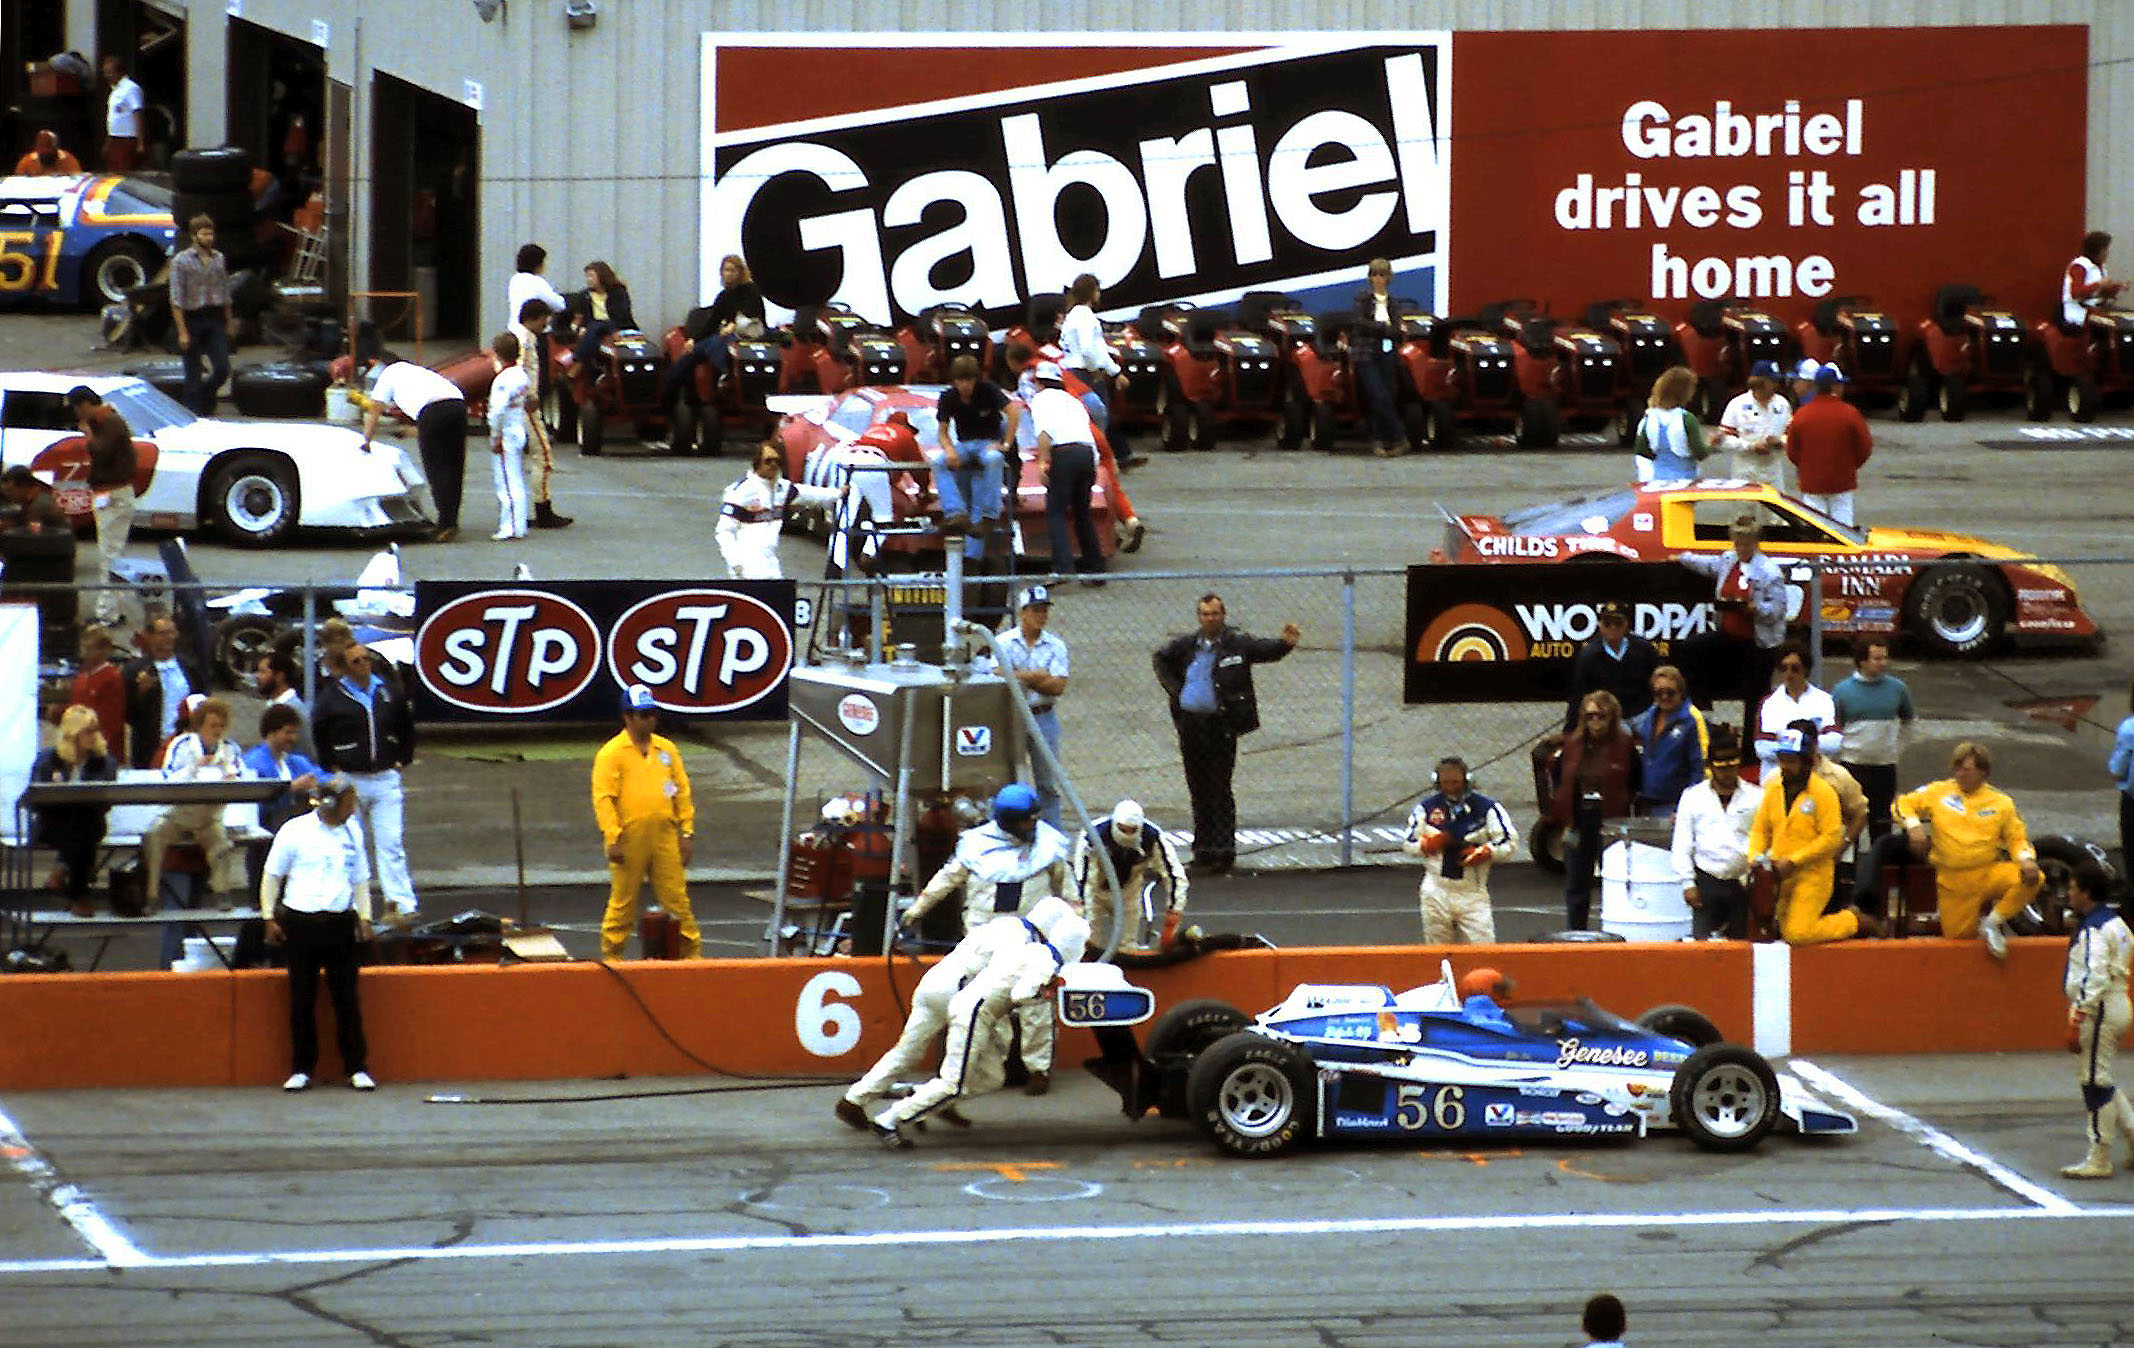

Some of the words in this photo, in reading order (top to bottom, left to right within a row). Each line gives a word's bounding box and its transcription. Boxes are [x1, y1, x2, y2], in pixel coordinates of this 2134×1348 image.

[1621, 100, 1863, 159] Gabriel
[714, 52, 1440, 328] Gabriel
[1554, 173, 1764, 229] drives
[1788, 170, 1836, 226] it
[1857, 168, 1936, 226] all
[0, 231, 63, 290] 51
[1651, 242, 1836, 299] home
[1479, 536, 1559, 557] CHILDS
[1841, 575, 1881, 596] INN
[438, 604, 578, 695] STP
[630, 604, 770, 695] STP
[1530, 643, 1575, 659] AUTO
[795, 970, 864, 1057] 6
[1068, 992, 1105, 1020] 56
[1555, 1037, 1649, 1070] Genesee
[1396, 1084, 1466, 1131] 56
